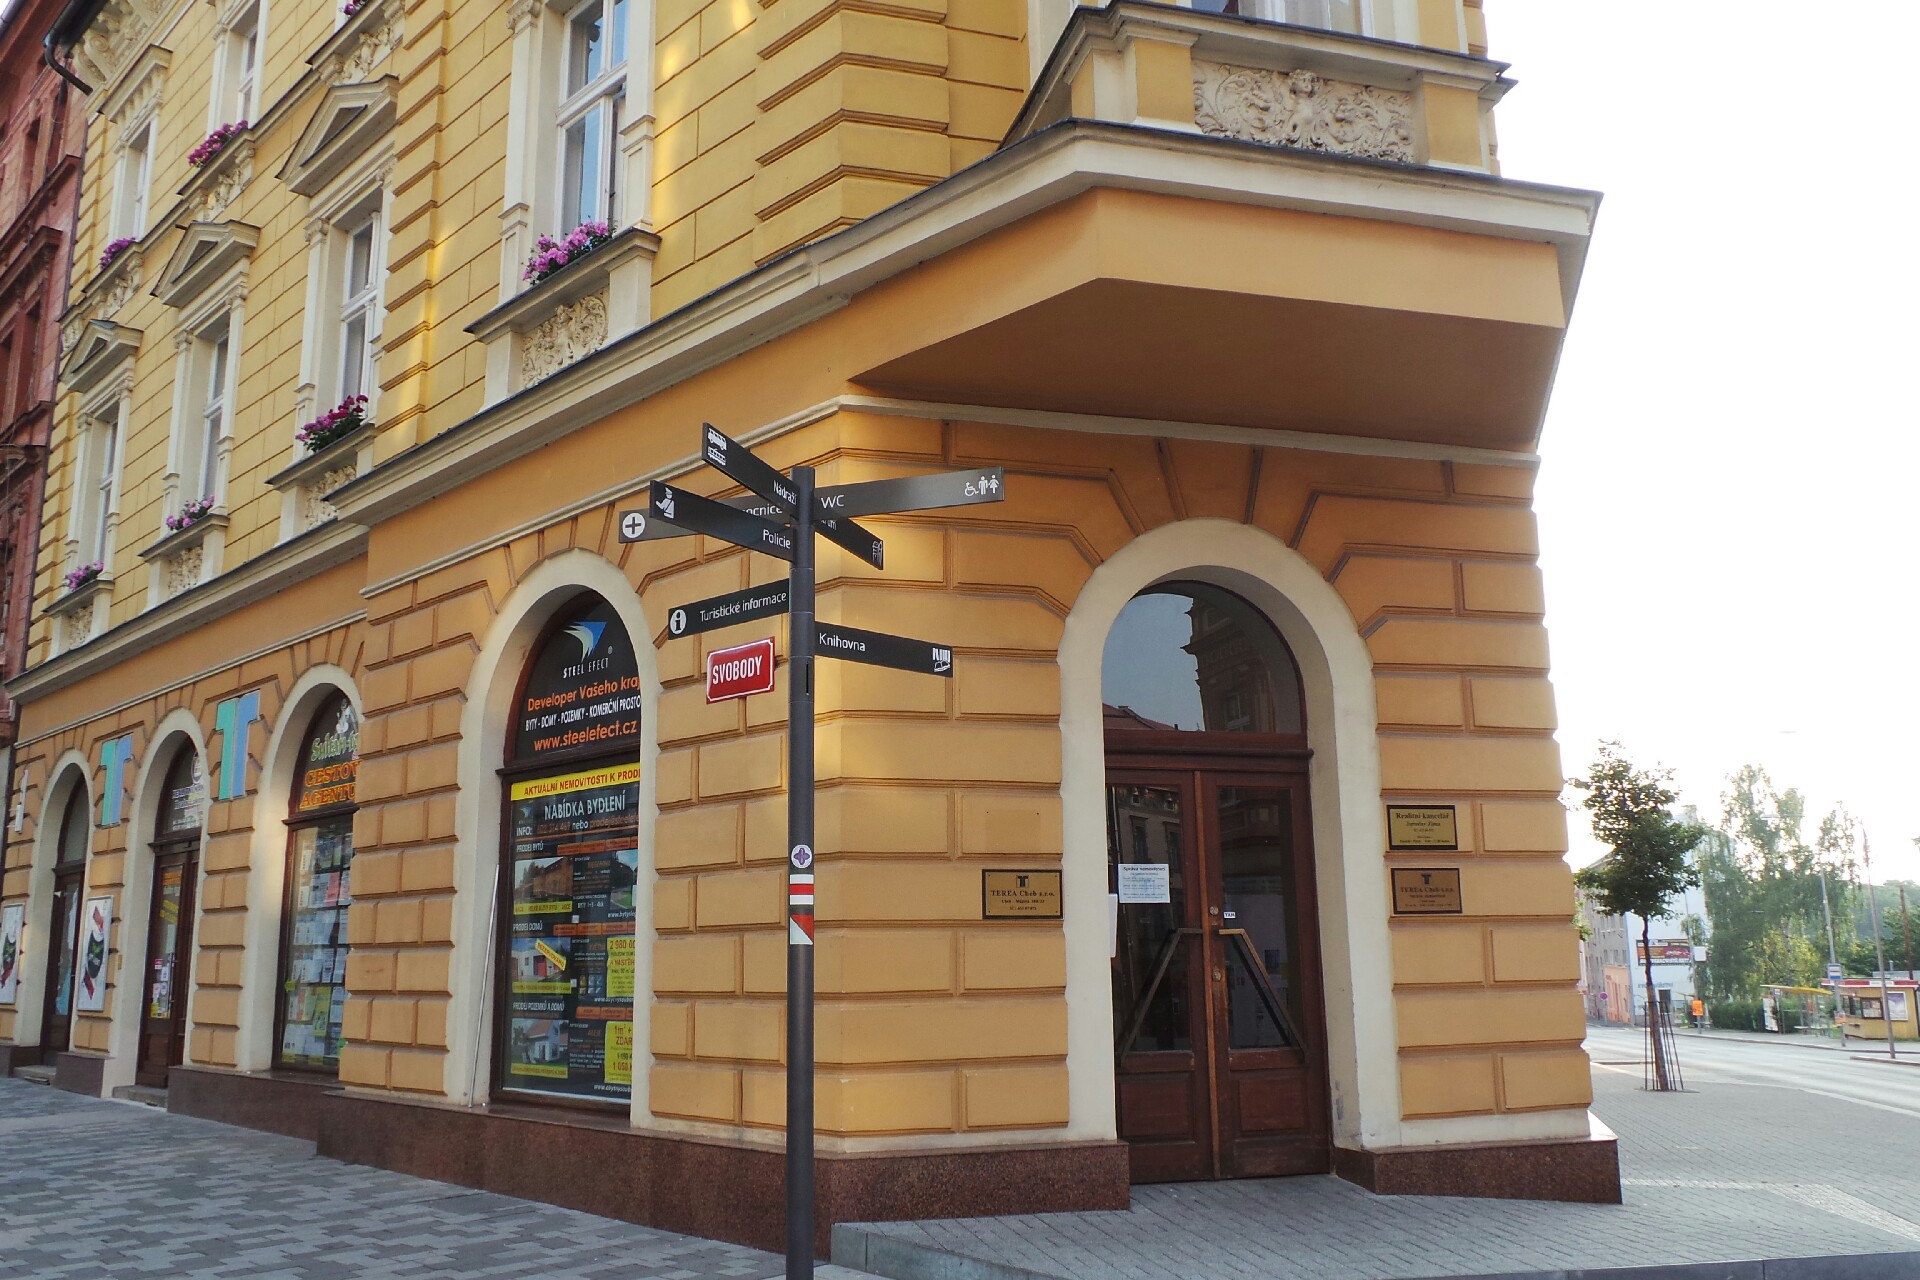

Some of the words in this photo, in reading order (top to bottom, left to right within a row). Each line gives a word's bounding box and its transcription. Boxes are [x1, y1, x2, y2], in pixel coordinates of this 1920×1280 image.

[773, 479, 797, 506] Nádraží
[820, 494, 845, 509] WC
[762, 529, 791, 550] Policie
[700, 602, 740, 622] Turistické
[742, 592, 787, 612] informace
[819, 632, 866, 652] Knihovna
[562, 664, 585, 679] STEEL
[588, 657, 609, 673] EFECT
[712, 655, 762, 685] SVOBODY
[527, 690, 577, 712] Developer
[579, 680, 618, 699] Vašeho
[534, 720, 638, 751] www.steelefect.cz
[524, 780, 558, 796] AKTUÁLNÍ
[559, 773, 608, 791] NEMOVITOSTI
[609, 773, 616, 783] K
[544, 798, 585, 820] NABÍDKA
[587, 790, 626, 815] BYDLENÍ
[516, 826, 533, 837] INFO:
[571, 819, 589, 831] nebo
[991, 889, 1018, 897] TEREA
